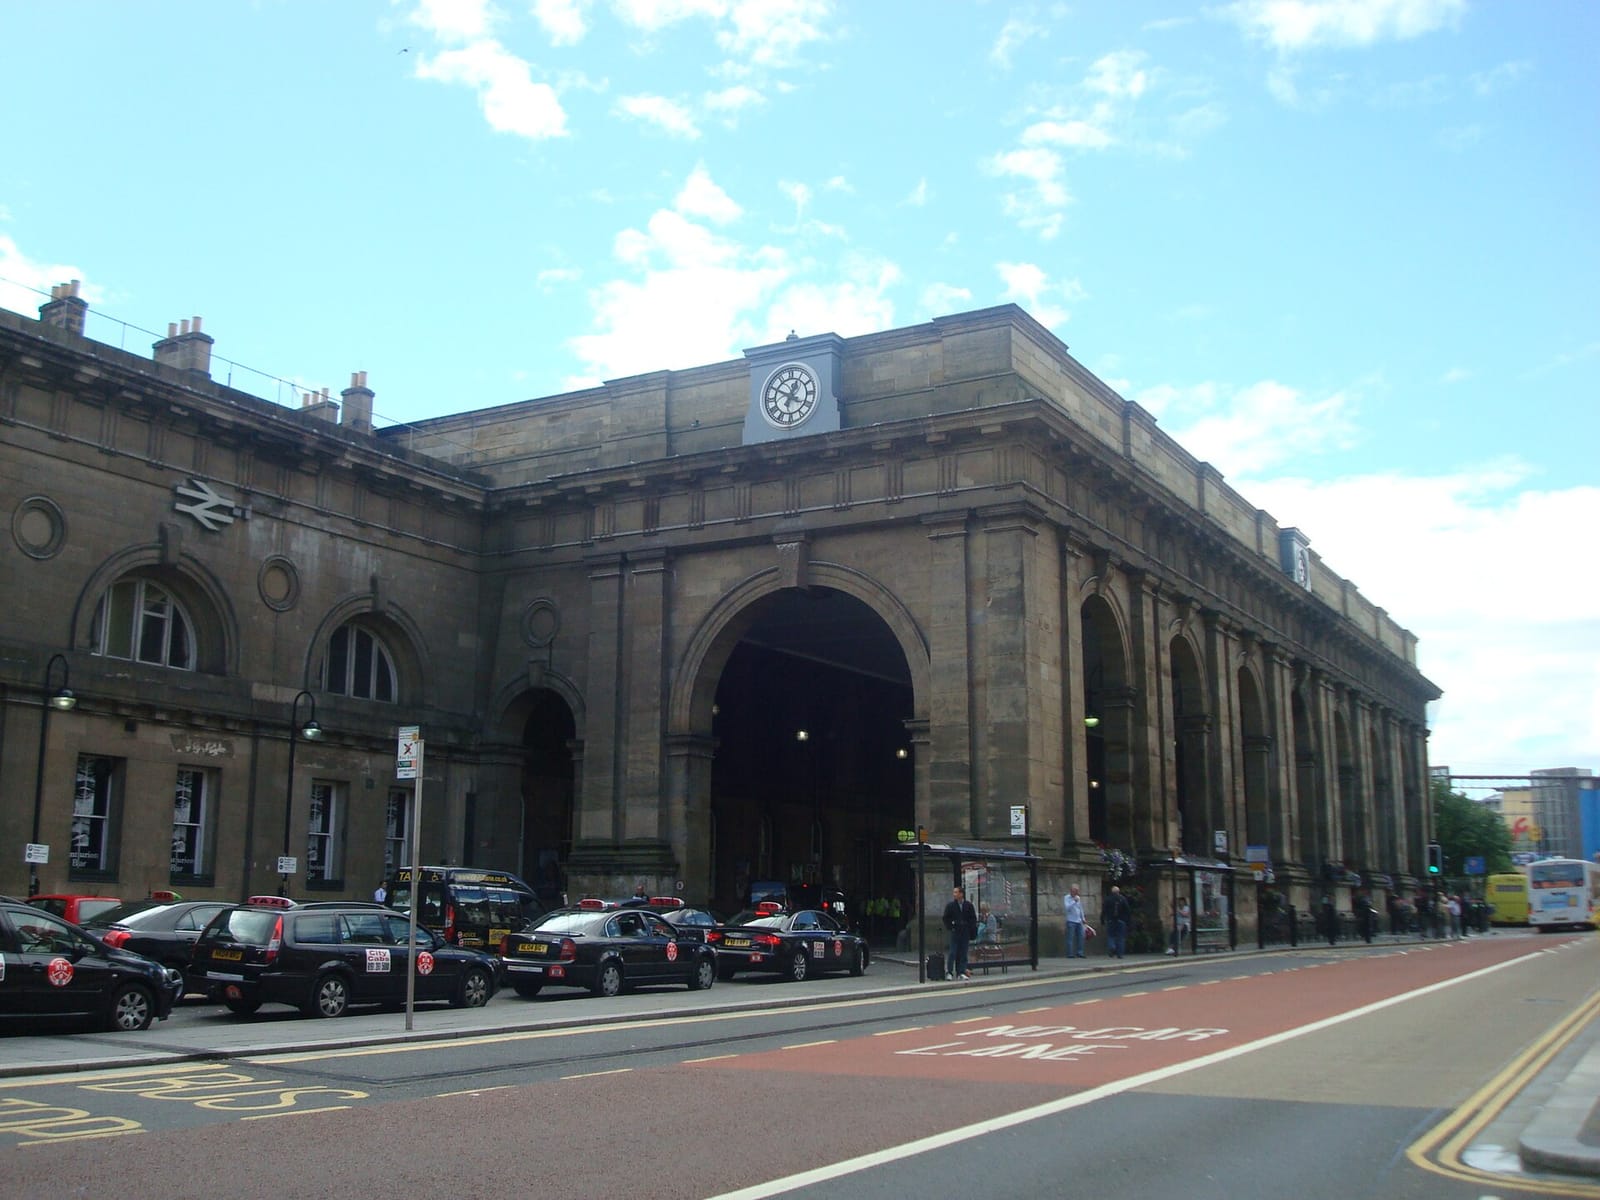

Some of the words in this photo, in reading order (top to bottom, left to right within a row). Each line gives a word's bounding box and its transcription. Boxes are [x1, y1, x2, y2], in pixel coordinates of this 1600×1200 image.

[399, 871, 422, 881] TAI
[251, 897, 288, 907] TAXI
[897, 1041, 1129, 1061] LANE
[77, 1073, 370, 1110] BUS
